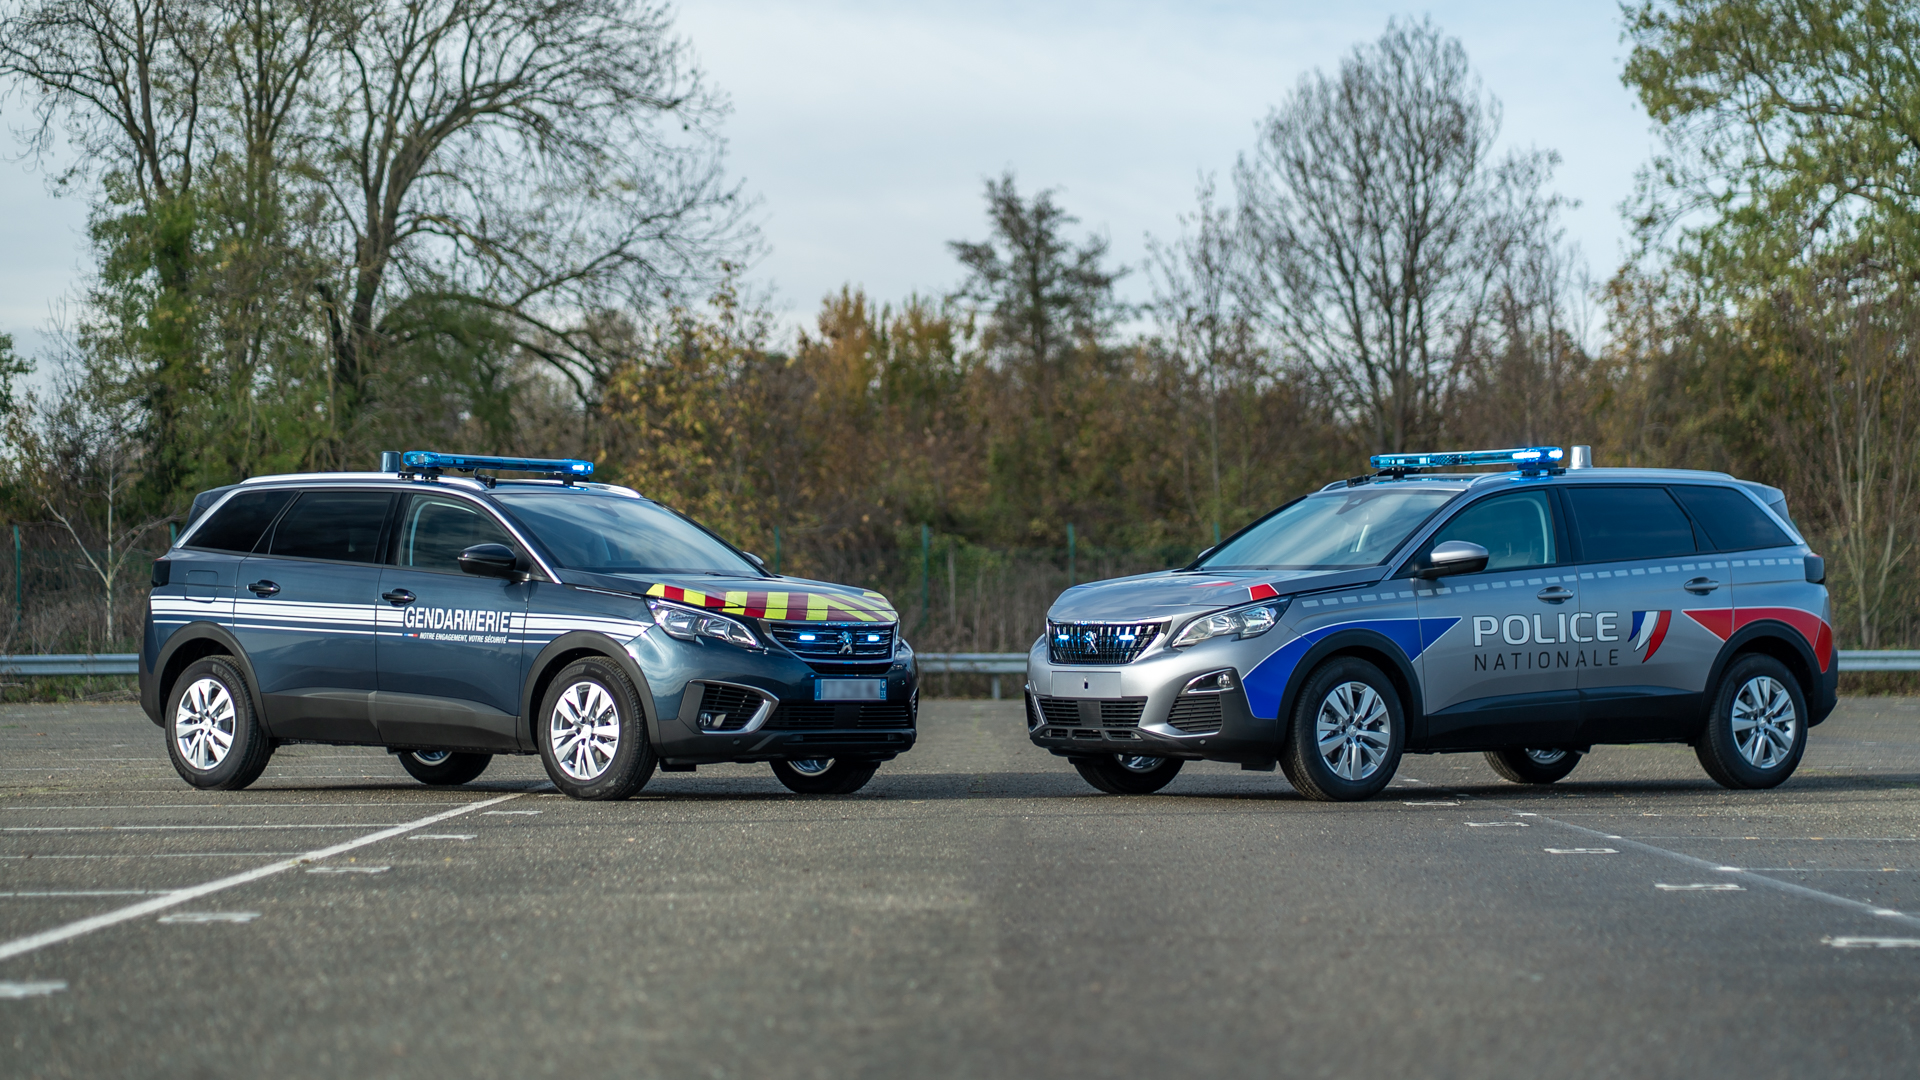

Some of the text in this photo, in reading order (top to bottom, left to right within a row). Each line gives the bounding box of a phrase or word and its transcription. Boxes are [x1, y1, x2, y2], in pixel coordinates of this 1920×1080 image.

[404, 606, 511, 633] GENDARMERIE
[1472, 611, 1619, 647] POLICE
[419, 632, 508, 644] NOTRE ENGAGEMENT, VOTRE SÉCURITÉ
[1474, 649, 1619, 671] NATIONALE
